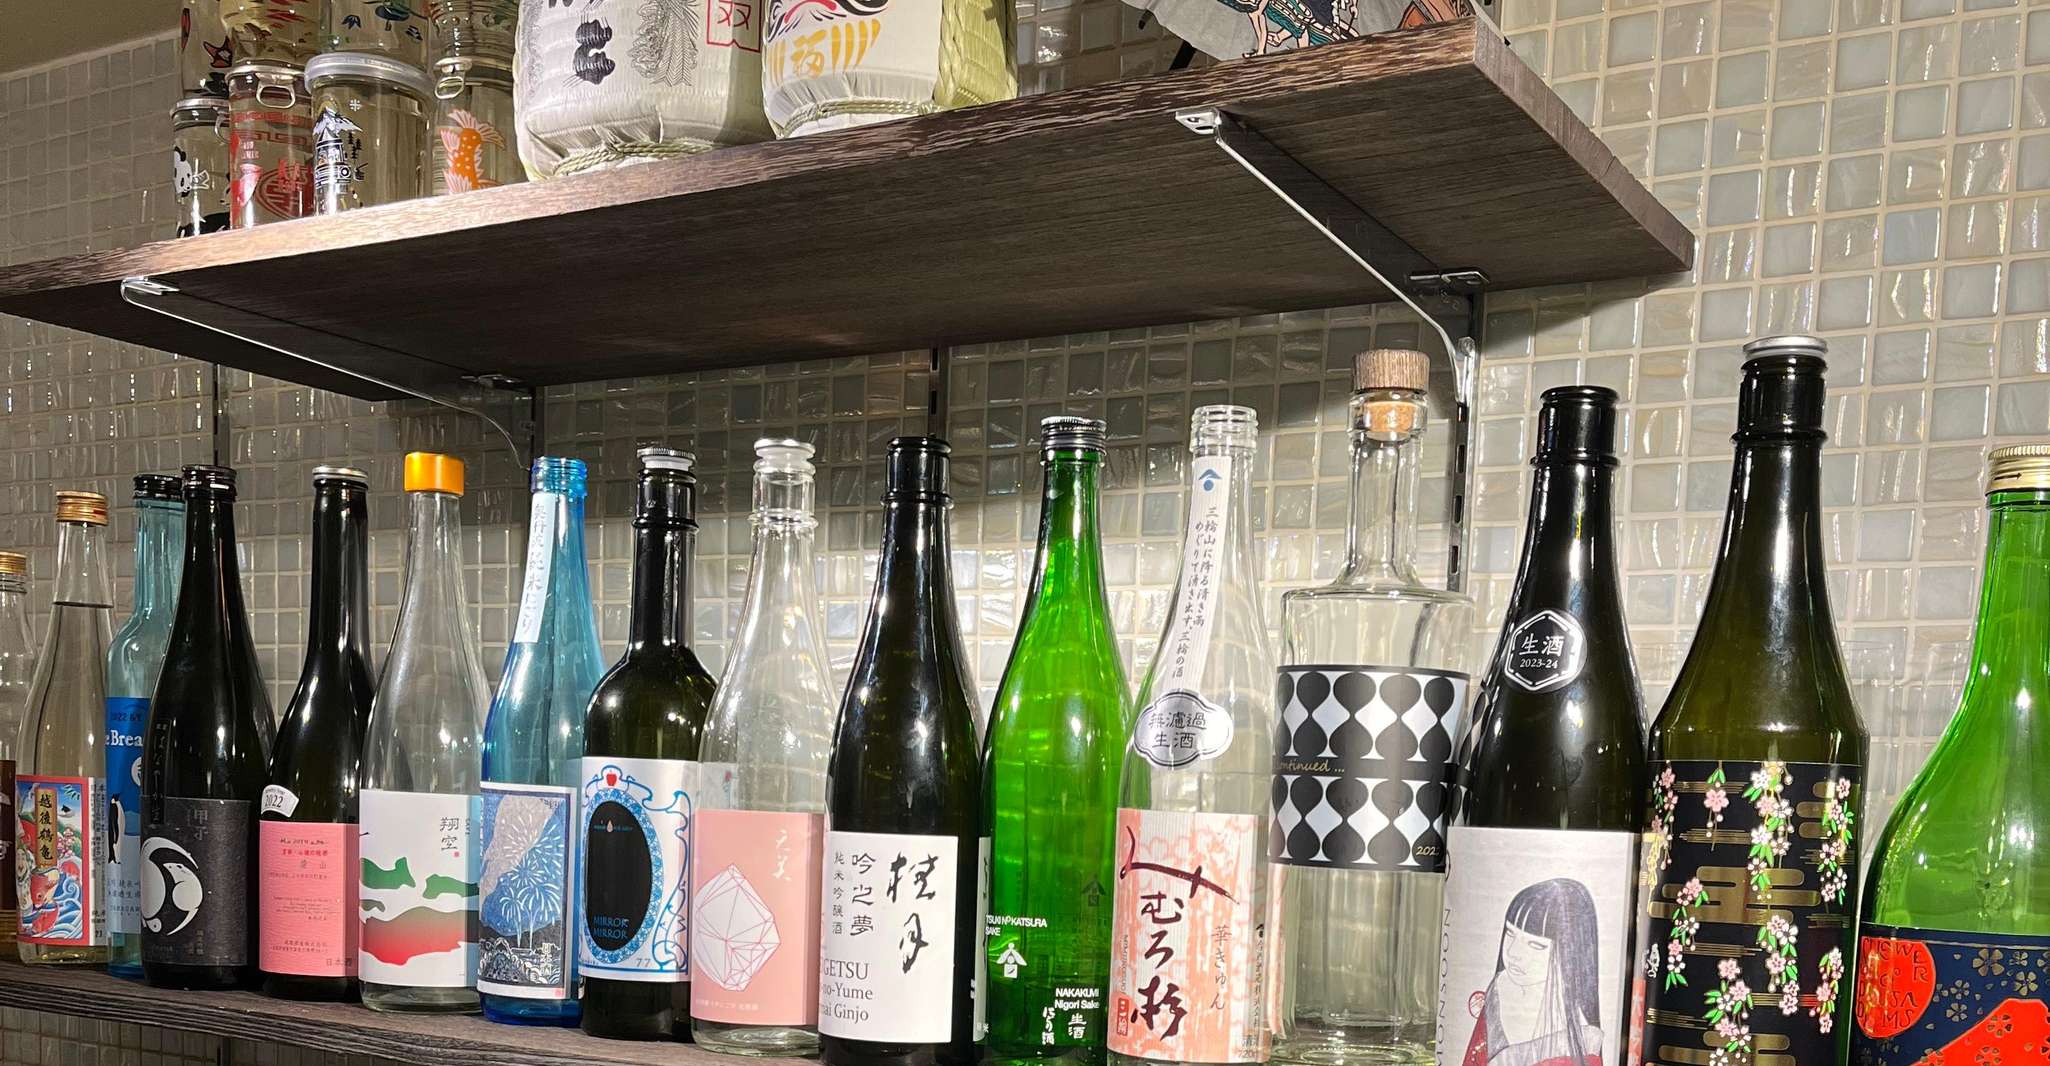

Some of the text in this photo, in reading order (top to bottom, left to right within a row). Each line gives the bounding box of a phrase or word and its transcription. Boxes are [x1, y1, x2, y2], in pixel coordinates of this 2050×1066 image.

[1519, 633, 1565, 657] 生酒
[1520, 658, 1559, 669] 2023-24
[1148, 711, 1207, 730] 無濾過
[1152, 731, 1197, 749] 生酒
[440, 816, 460, 851] 翔空
[849, 852, 877, 937] 吟之夢
[593, 915, 630, 928] MIRROR
[1011, 916, 1048, 928] KATSURA
[593, 928, 630, 940] MIRROR
[1119, 825, 1240, 1041] みむろ杉
[1211, 924, 1232, 1010] 華きゅん
[1055, 987, 1100, 998] NAKAKUMI
[834, 1002, 869, 1024] Ginjo
[1055, 999, 1080, 1011] Nigori
[1068, 1013, 1087, 1039] 生酒
